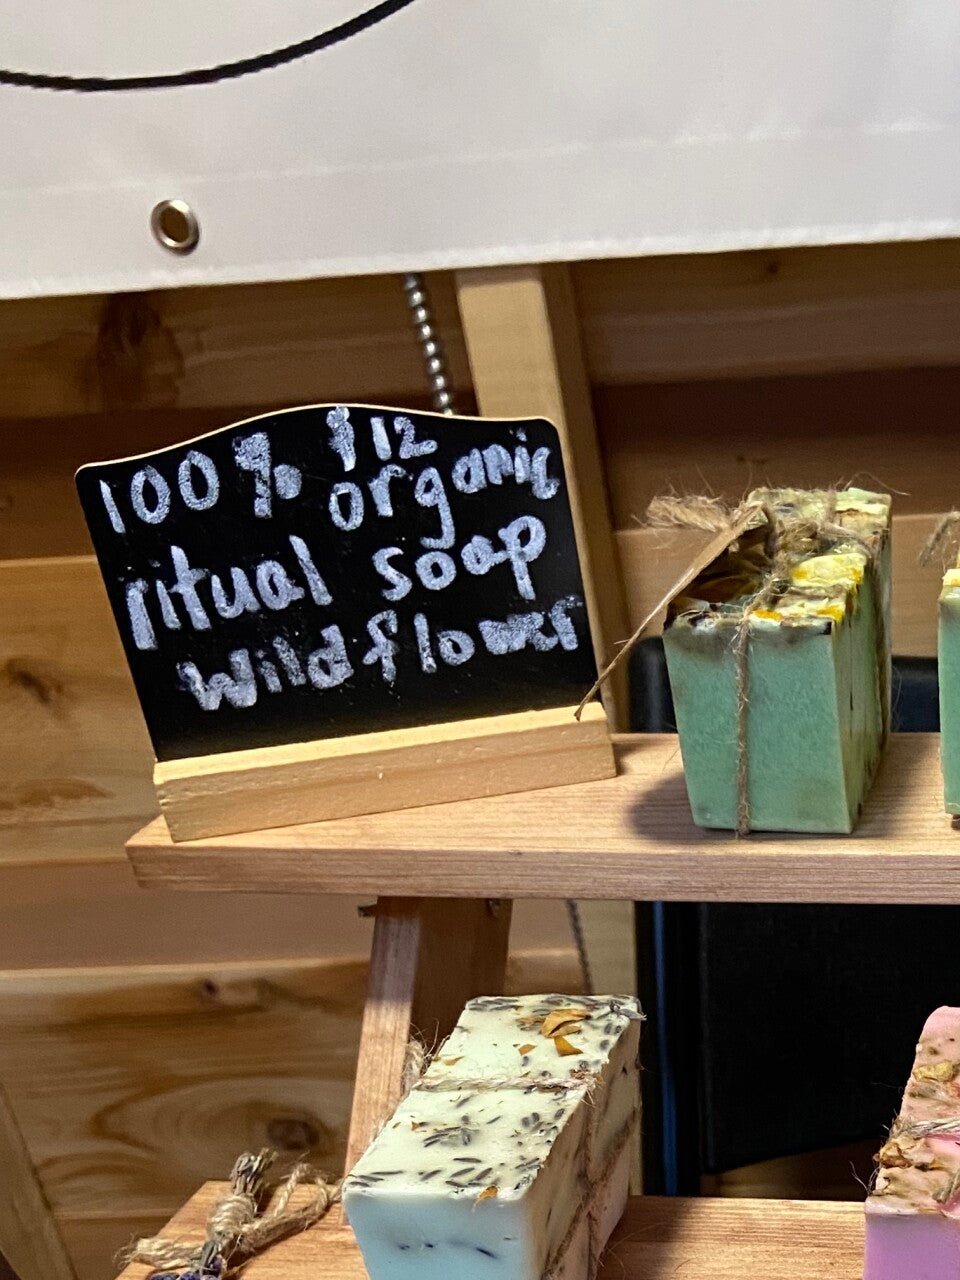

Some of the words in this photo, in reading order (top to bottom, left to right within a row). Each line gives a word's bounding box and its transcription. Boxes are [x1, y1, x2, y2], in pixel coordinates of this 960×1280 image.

[330, 428, 560, 549] organic
[126, 535, 332, 651] ritual
[373, 515, 546, 601] soap
